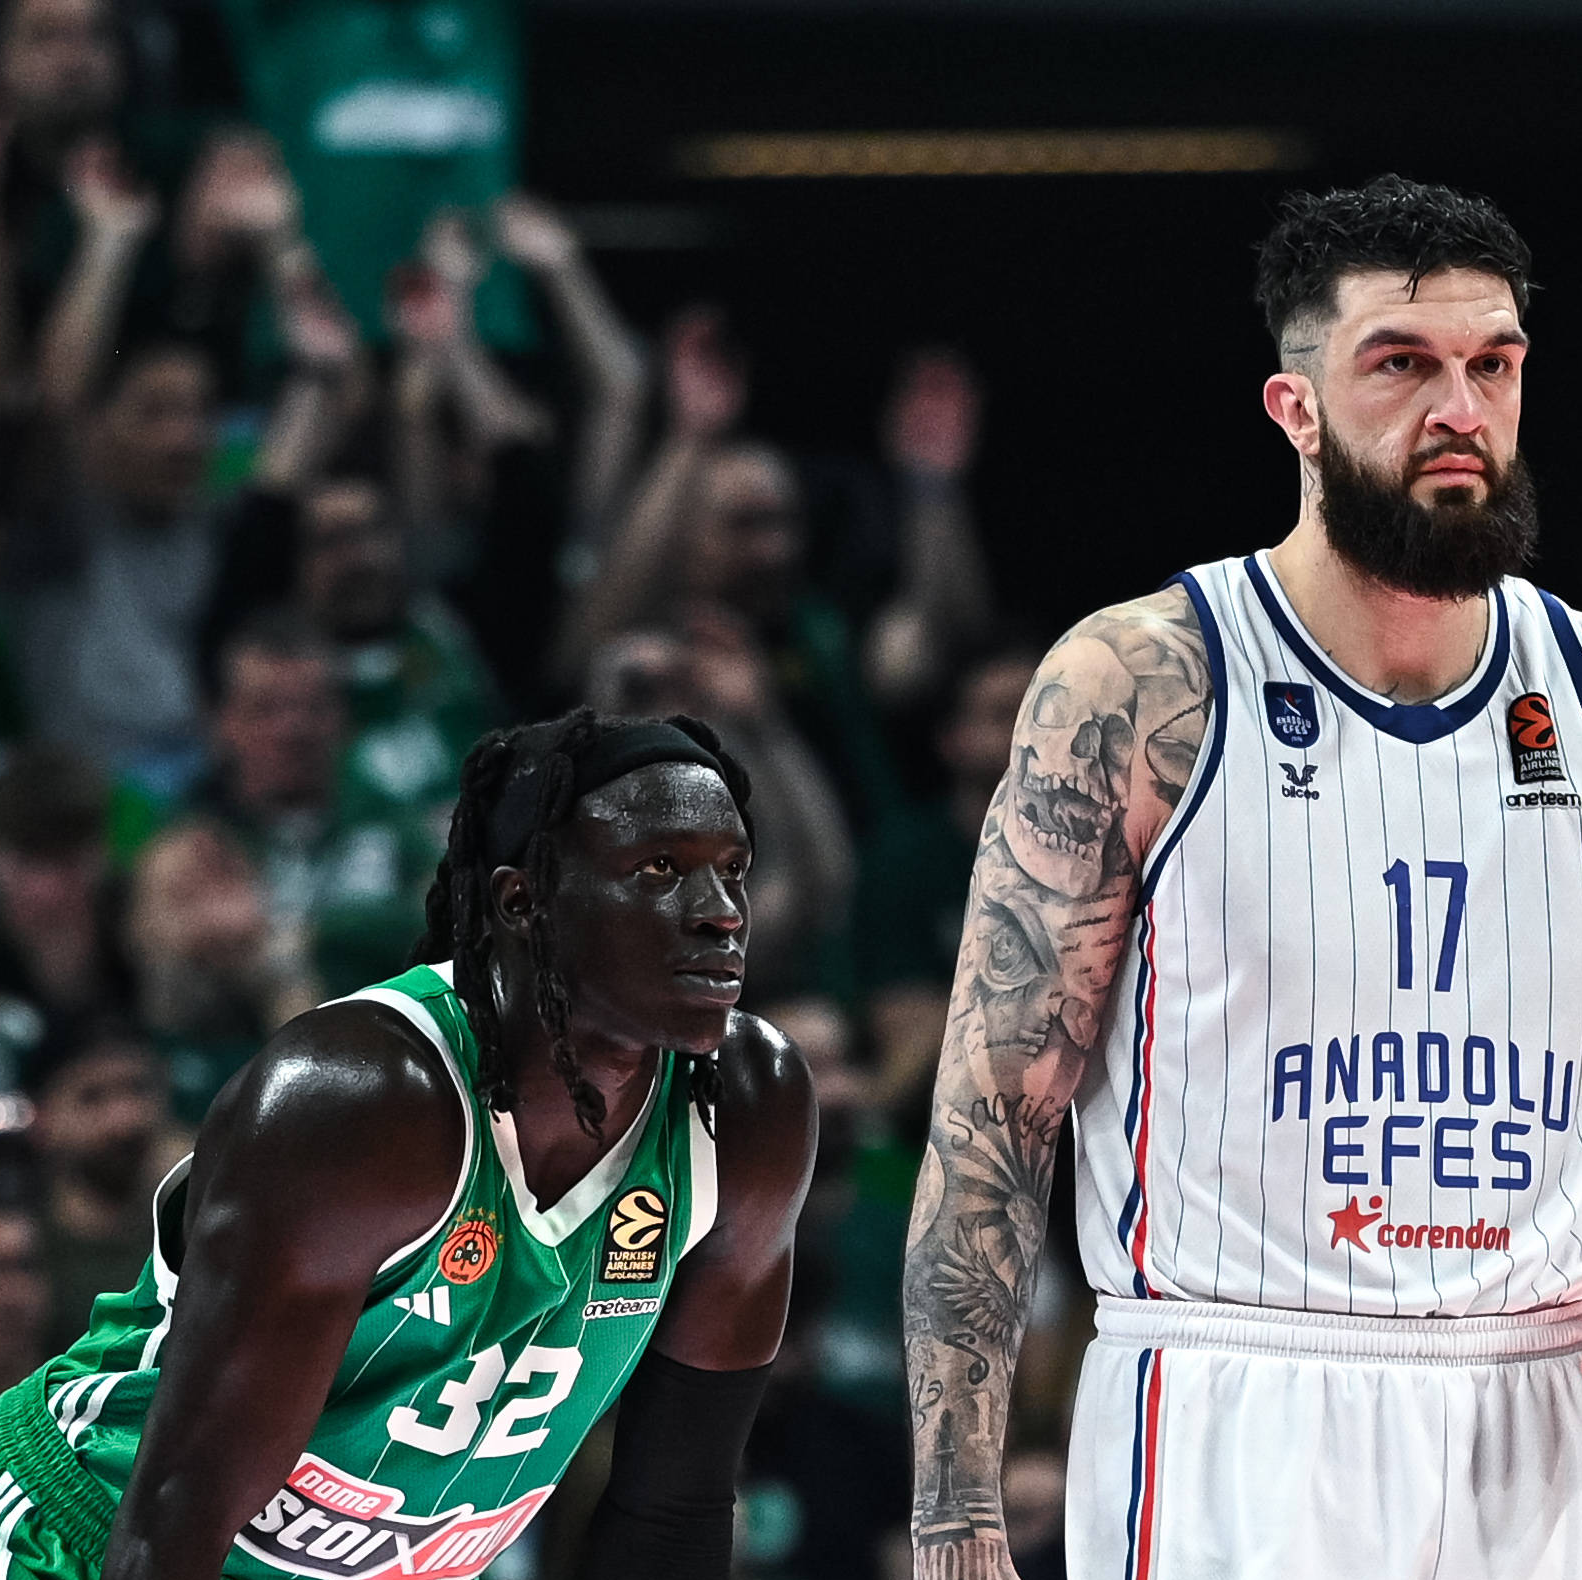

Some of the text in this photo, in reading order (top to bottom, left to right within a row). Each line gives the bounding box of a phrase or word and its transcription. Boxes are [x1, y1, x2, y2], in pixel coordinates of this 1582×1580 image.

[1519, 749, 1559, 763] TURKIS
[1505, 789, 1582, 808] oneteam
[1383, 858, 1468, 992] 17
[1272, 1031, 1573, 1132] ANADOLU
[1322, 1115, 1532, 1190] EFES
[1377, 1218, 1510, 1250] corendon
[605, 1260, 655, 1271] AIRLINES
[608, 1251, 657, 1261] TURKISH
[584, 1298, 657, 1317] oneteam
[385, 1343, 584, 1459] 32
[293, 1469, 381, 1515] pame
